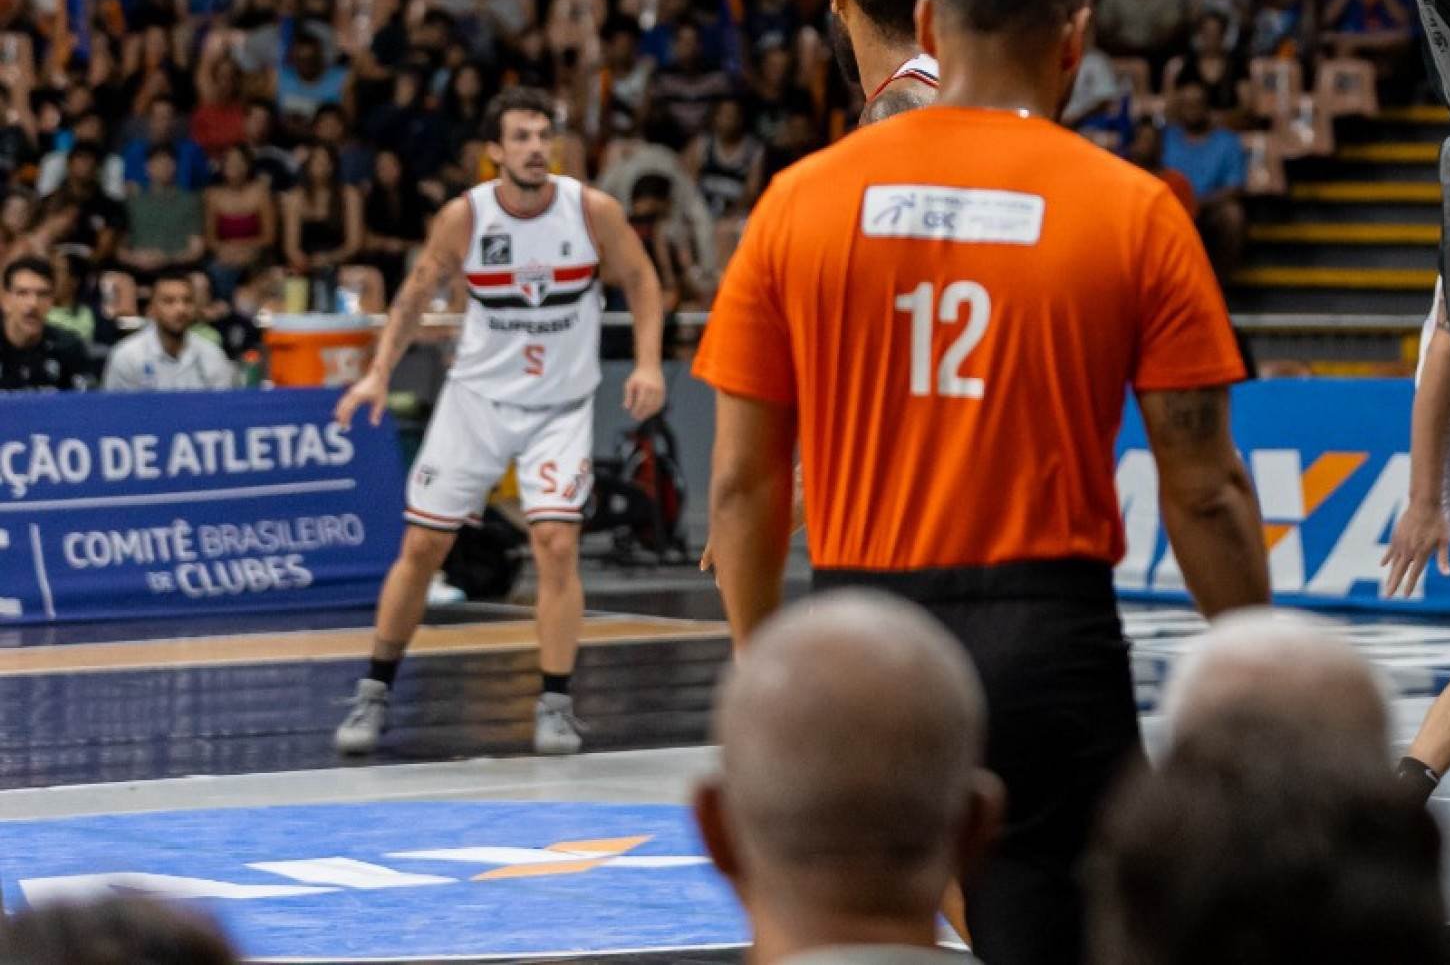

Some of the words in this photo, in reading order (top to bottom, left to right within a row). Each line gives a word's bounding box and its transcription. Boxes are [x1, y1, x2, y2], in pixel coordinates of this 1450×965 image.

[895, 280, 992, 399] 12
[0, 434, 91, 498] ÇÃO
[101, 435, 161, 481] DE
[168, 422, 355, 477] ATLETAS
[63, 518, 196, 568] COMITÊ
[200, 513, 365, 558] BRASILEIRO
[175, 553, 314, 598] CLUBES
